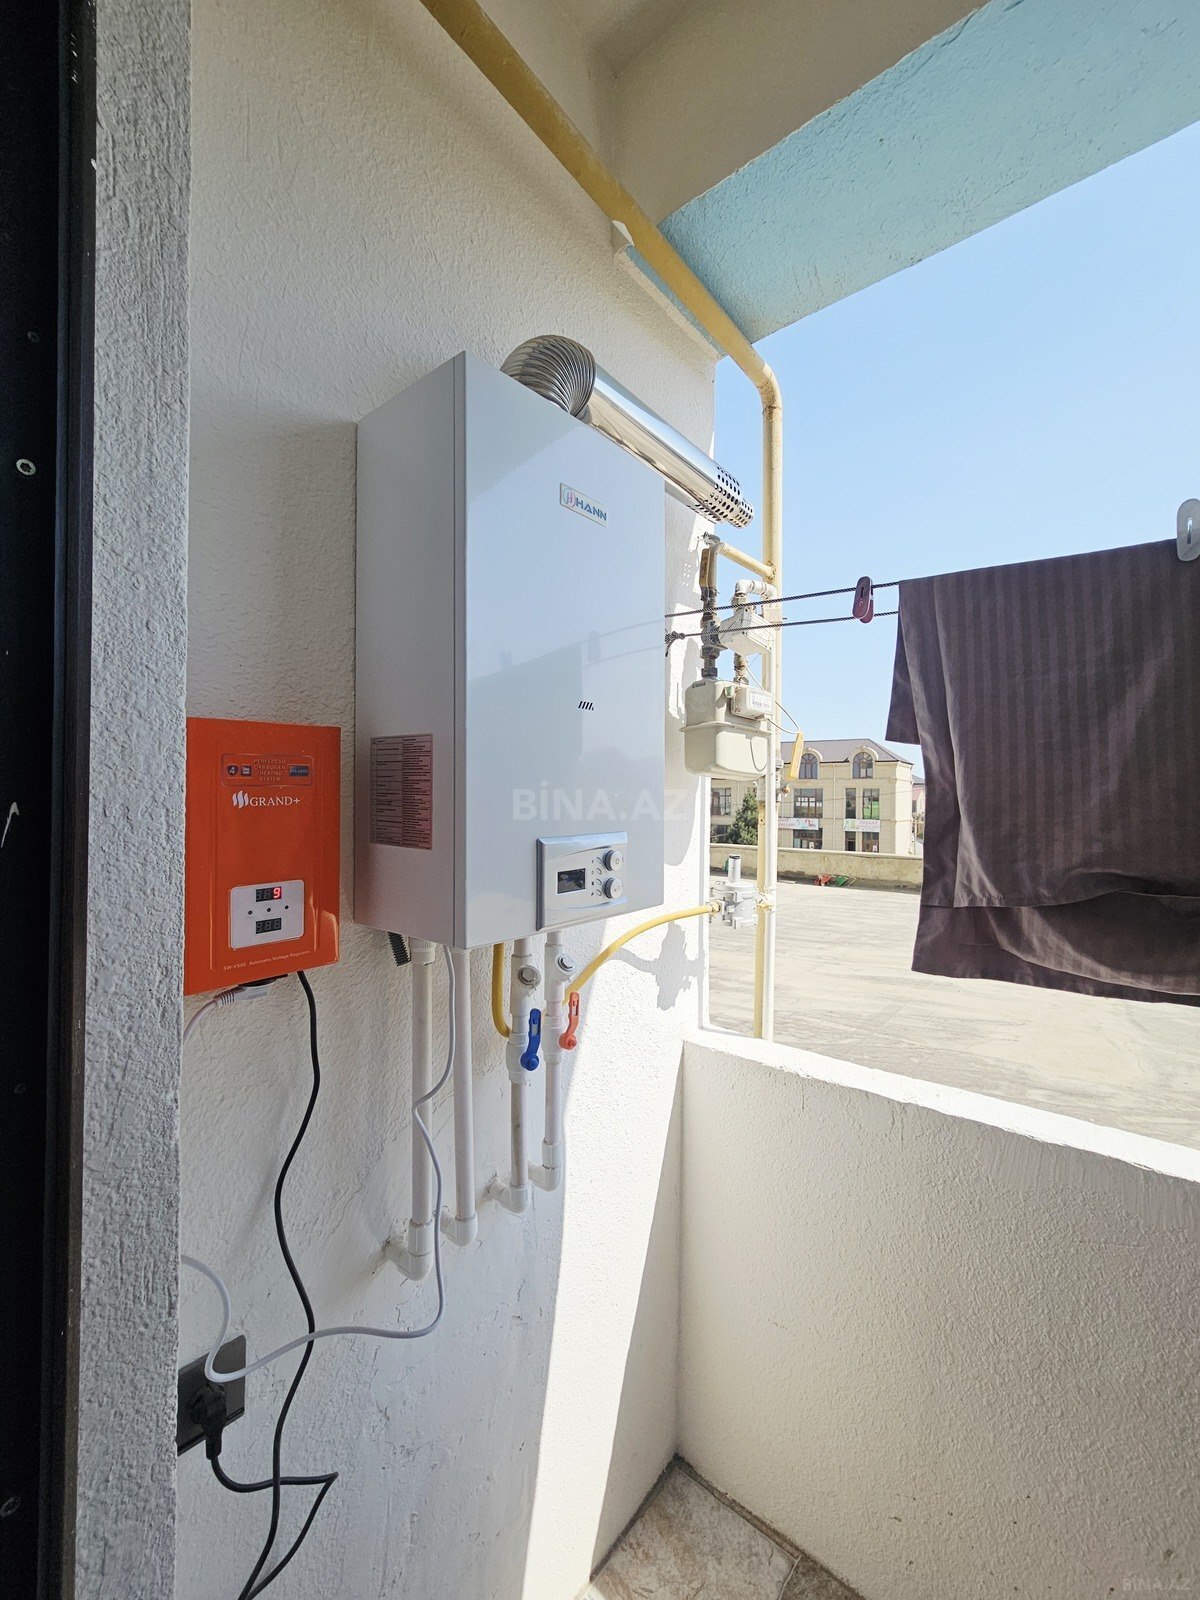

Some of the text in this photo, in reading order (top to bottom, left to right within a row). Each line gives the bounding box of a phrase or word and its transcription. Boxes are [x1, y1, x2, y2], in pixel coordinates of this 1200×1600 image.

[576, 497, 607, 521] HANN
[229, 766, 236, 775] 4
[249, 796, 301, 807] GRAND+
[273, 887, 281, 899] 9
